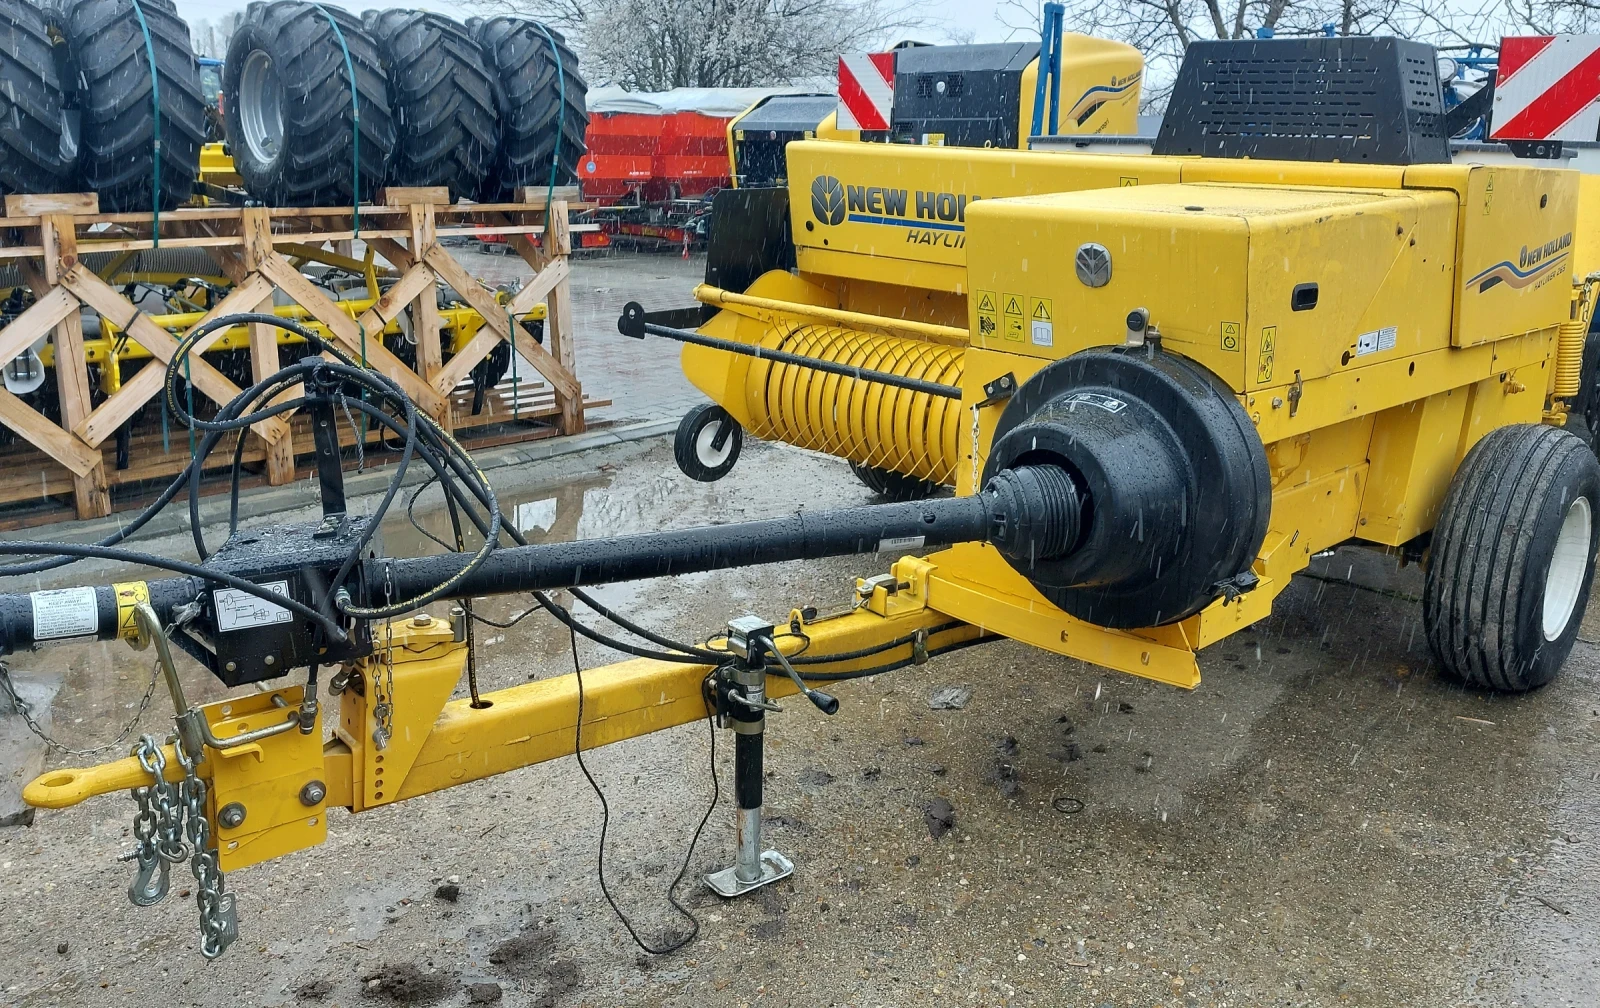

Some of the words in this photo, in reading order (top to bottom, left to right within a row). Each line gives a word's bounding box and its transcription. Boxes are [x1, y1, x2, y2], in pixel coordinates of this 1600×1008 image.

[847, 184, 908, 217] NEW
[1527, 246, 1543, 267] NEW
[1543, 232, 1572, 259] HOLLAND
[1534, 272, 1556, 291] HAYLINER
